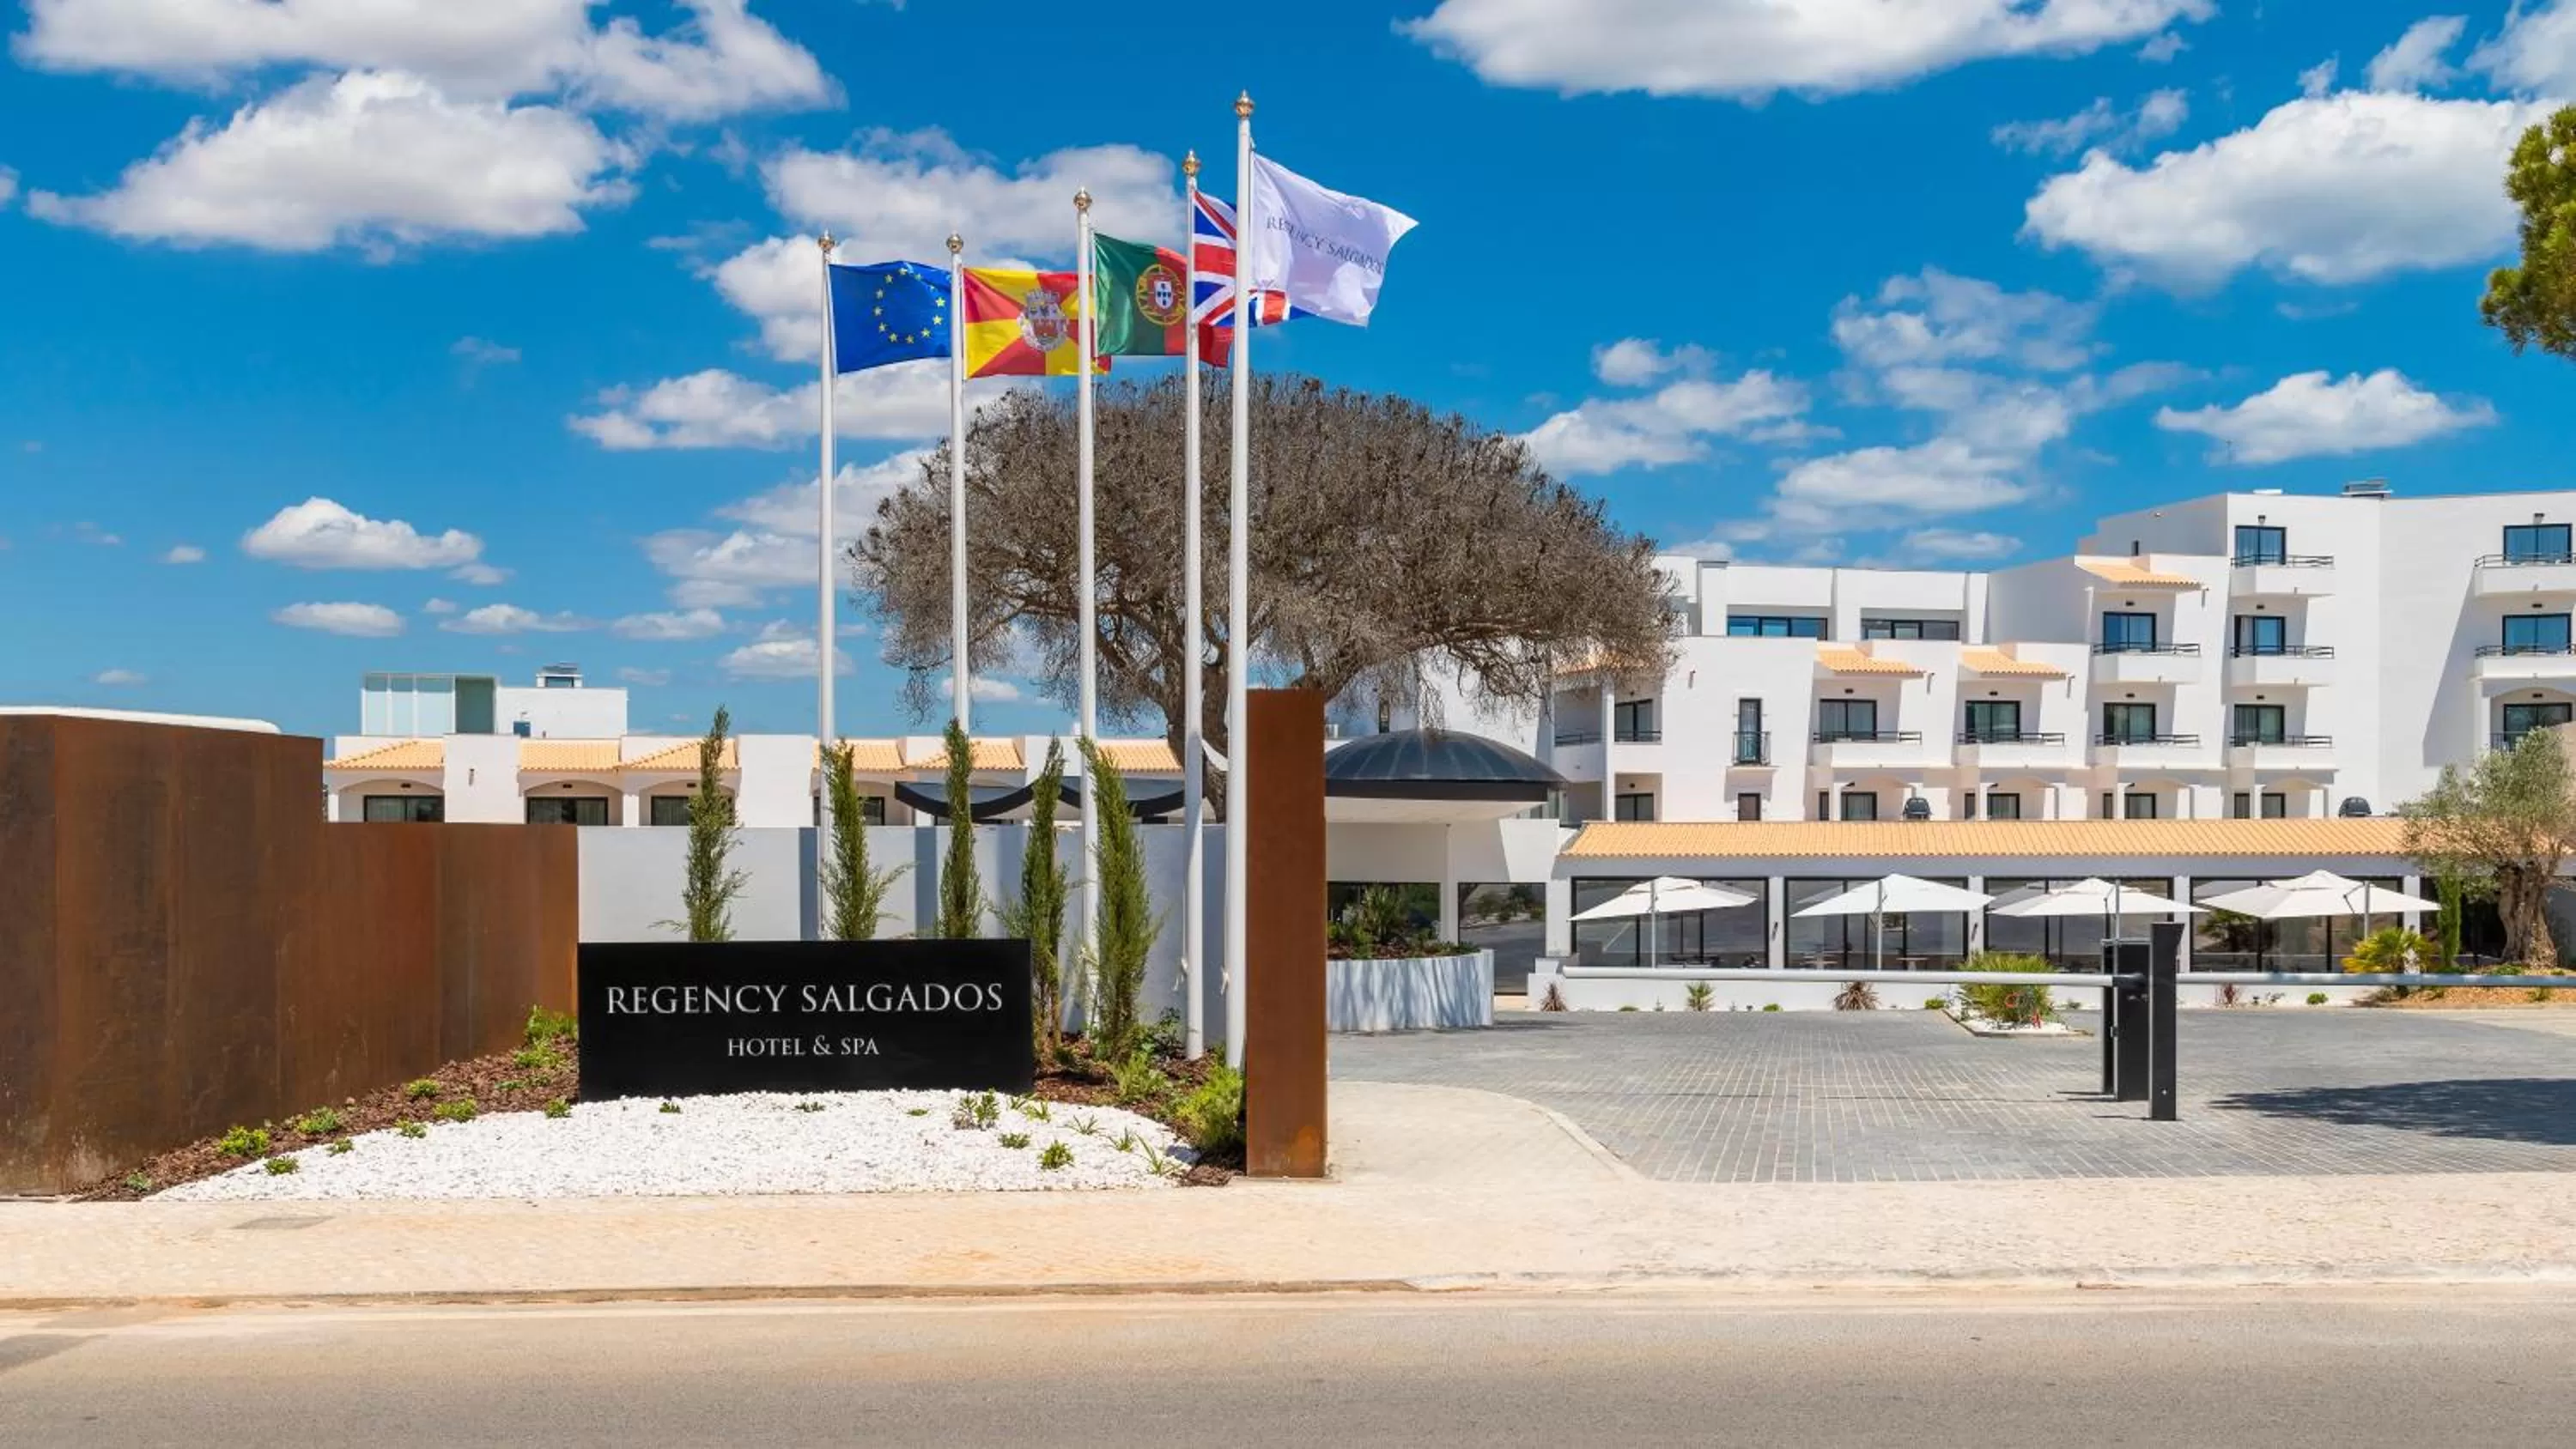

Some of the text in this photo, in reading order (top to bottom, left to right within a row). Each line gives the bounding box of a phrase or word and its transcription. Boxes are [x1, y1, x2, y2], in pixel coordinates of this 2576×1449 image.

[1266, 216, 1324, 249] REGENCY
[606, 983, 1004, 1014] REGENCY SALGADOS
[727, 1034, 880, 1057] HOTEL & SPA
